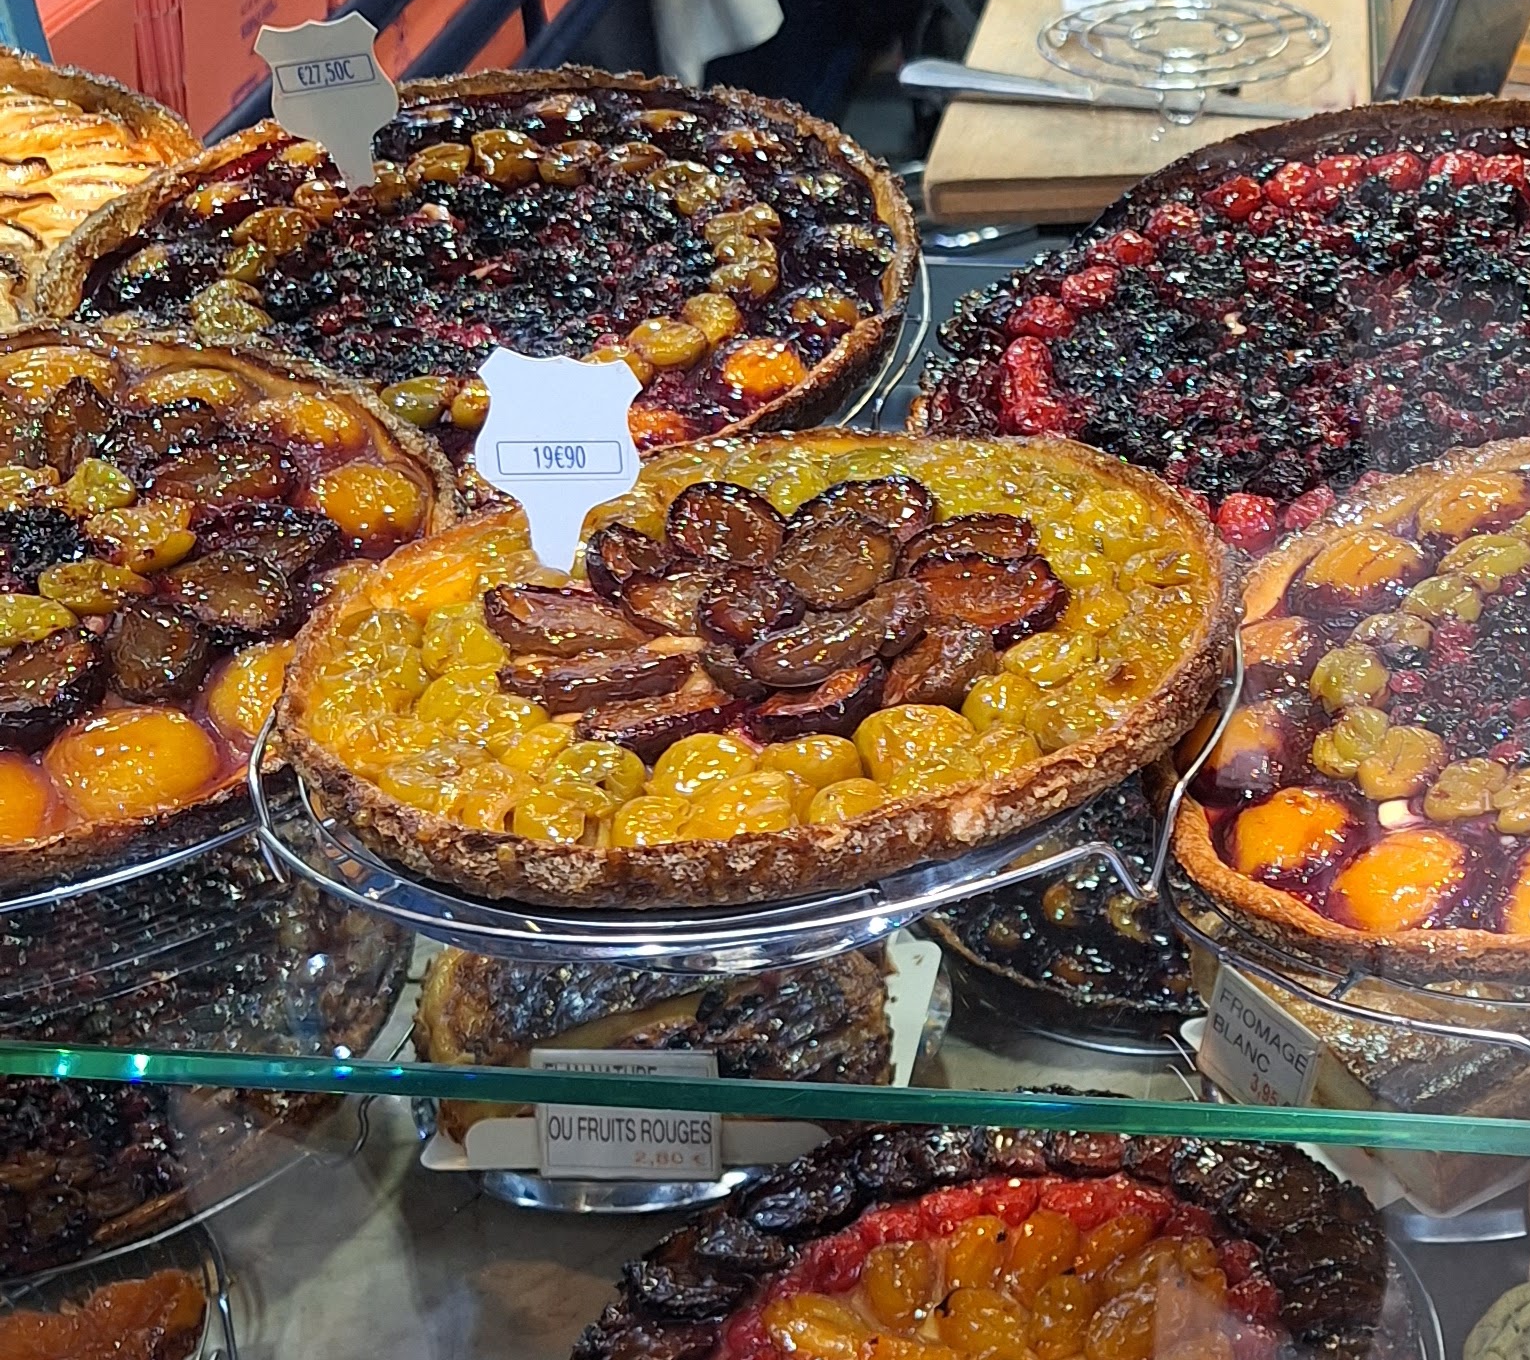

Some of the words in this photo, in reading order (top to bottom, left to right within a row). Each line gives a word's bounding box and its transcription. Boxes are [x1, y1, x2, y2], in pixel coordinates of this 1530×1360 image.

[533, 445, 586, 469] 19€90
[1213, 1013, 1270, 1073] BLANC
[1220, 988, 1309, 1076] FROMAGE
[550, 1115, 573, 1141] OU
[578, 1117, 636, 1142] FRUITS
[641, 1119, 712, 1144] ROUGES
